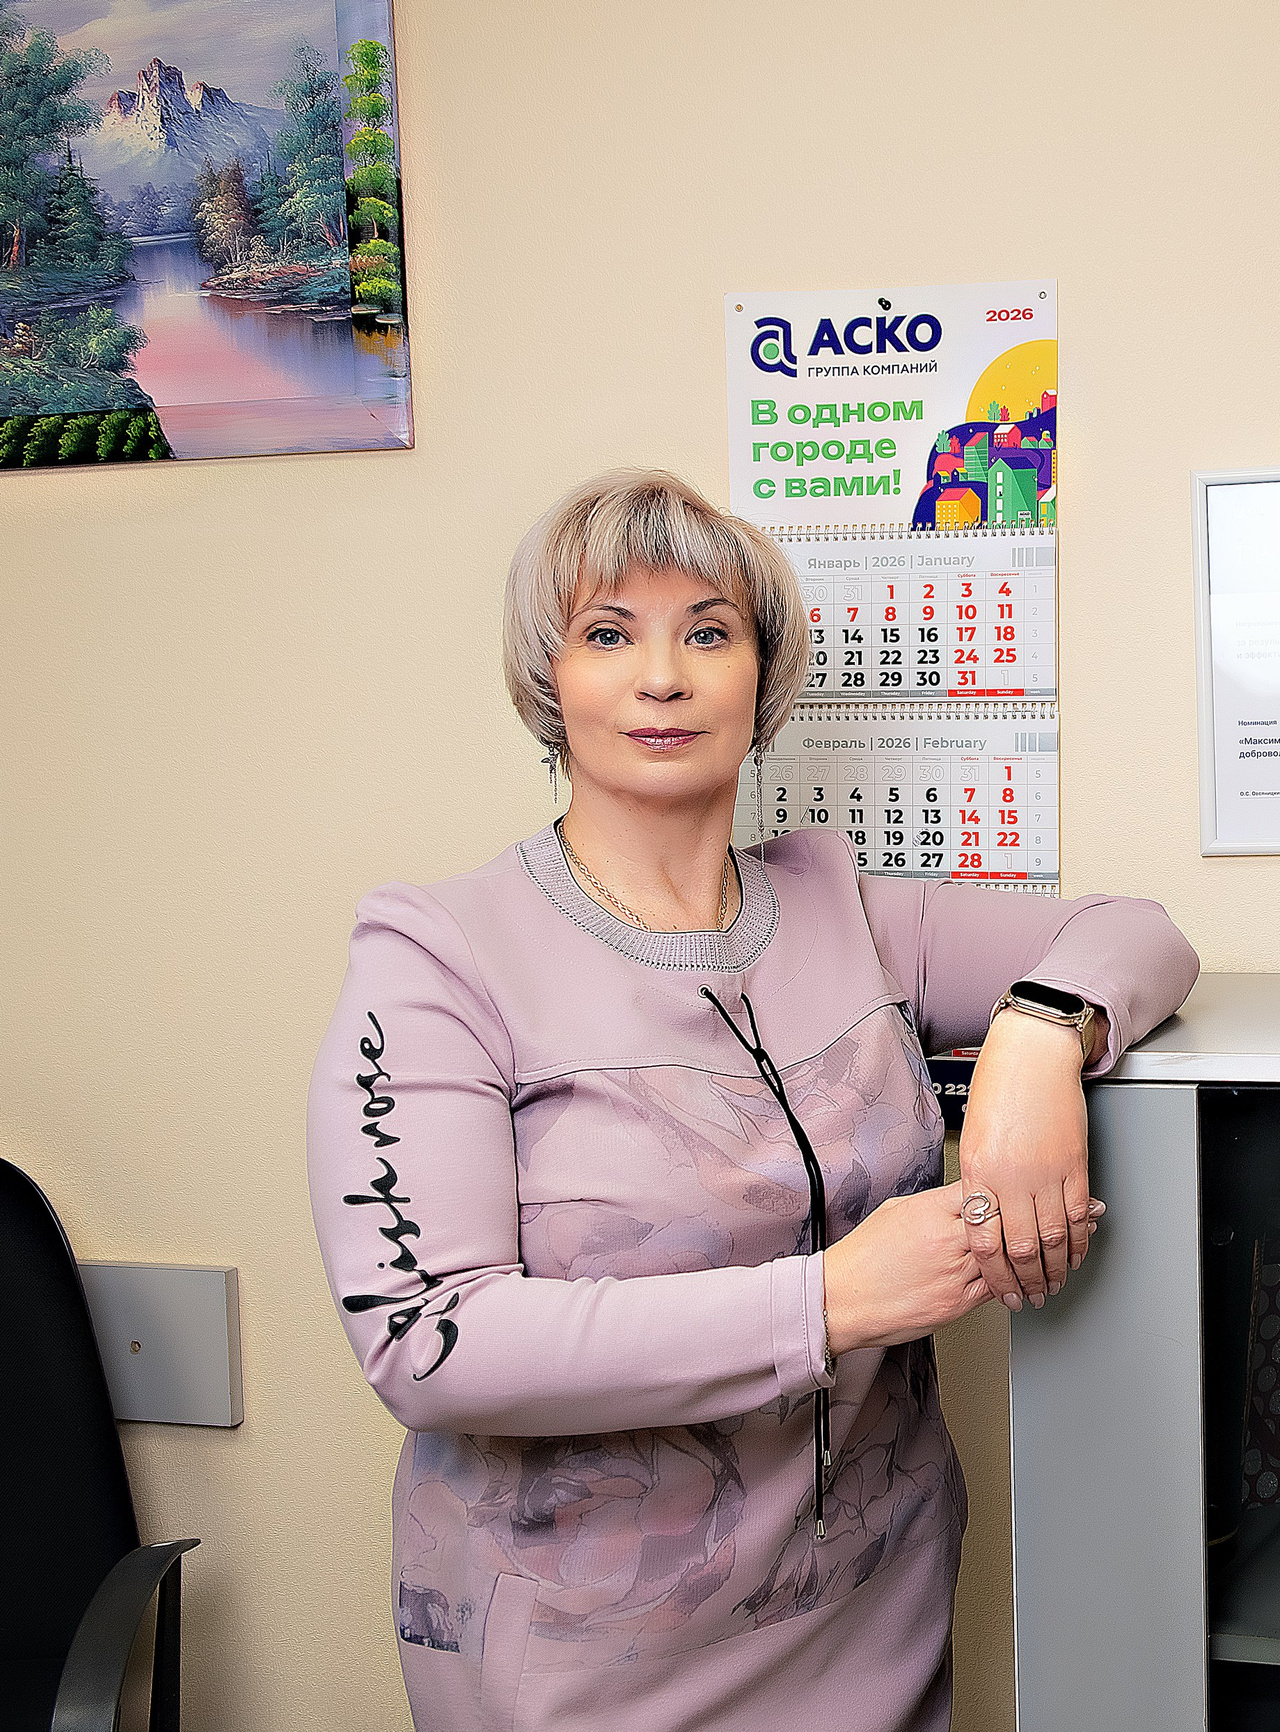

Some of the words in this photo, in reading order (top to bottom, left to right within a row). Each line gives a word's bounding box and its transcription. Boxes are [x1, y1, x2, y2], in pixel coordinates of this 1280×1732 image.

[985, 307, 1034, 322] 2026
[806, 313, 943, 356] АСКО
[807, 365, 860, 378] ГРУППА
[863, 359, 938, 376] КОМПАНИЙ
[750, 399, 779, 426] В
[787, 399, 924, 429] одном
[752, 438, 897, 467] городе
[752, 478, 776, 499] с
[784, 468, 901, 498] вами!
[807, 557, 861, 571] Январь
[871, 555, 906, 568] 2026
[917, 555, 975, 568] January
[887, 584, 894, 600] 1
[923, 583, 935, 599] 2
[961, 582, 973, 598] 3
[998, 581, 1012, 597] 4
[809, 607, 821, 623] 6
[846, 607, 859, 623] 7
[884, 606, 897, 622] 8
[922, 605, 935, 621] 9
[955, 604, 977, 620] 10
[997, 603, 1013, 619] 11
[1238, 719, 1278, 727] Номинация
[802, 737, 866, 753] Февраль
[877, 737, 911, 749] 2026
[923, 736, 987, 751] February
[776, 786, 788, 802] 2
[813, 786, 825, 802] 3
[849, 787, 863, 803] 4
[888, 787, 900, 803] 5
[925, 787, 938, 803] 6
[963, 787, 976, 803] 7
[1001, 787, 1015, 803] 8
[882, 852, 906, 868] 26
[919, 852, 944, 872] 27
[957, 852, 983, 869] 28
[355, 1011, 401, 1148] rose
